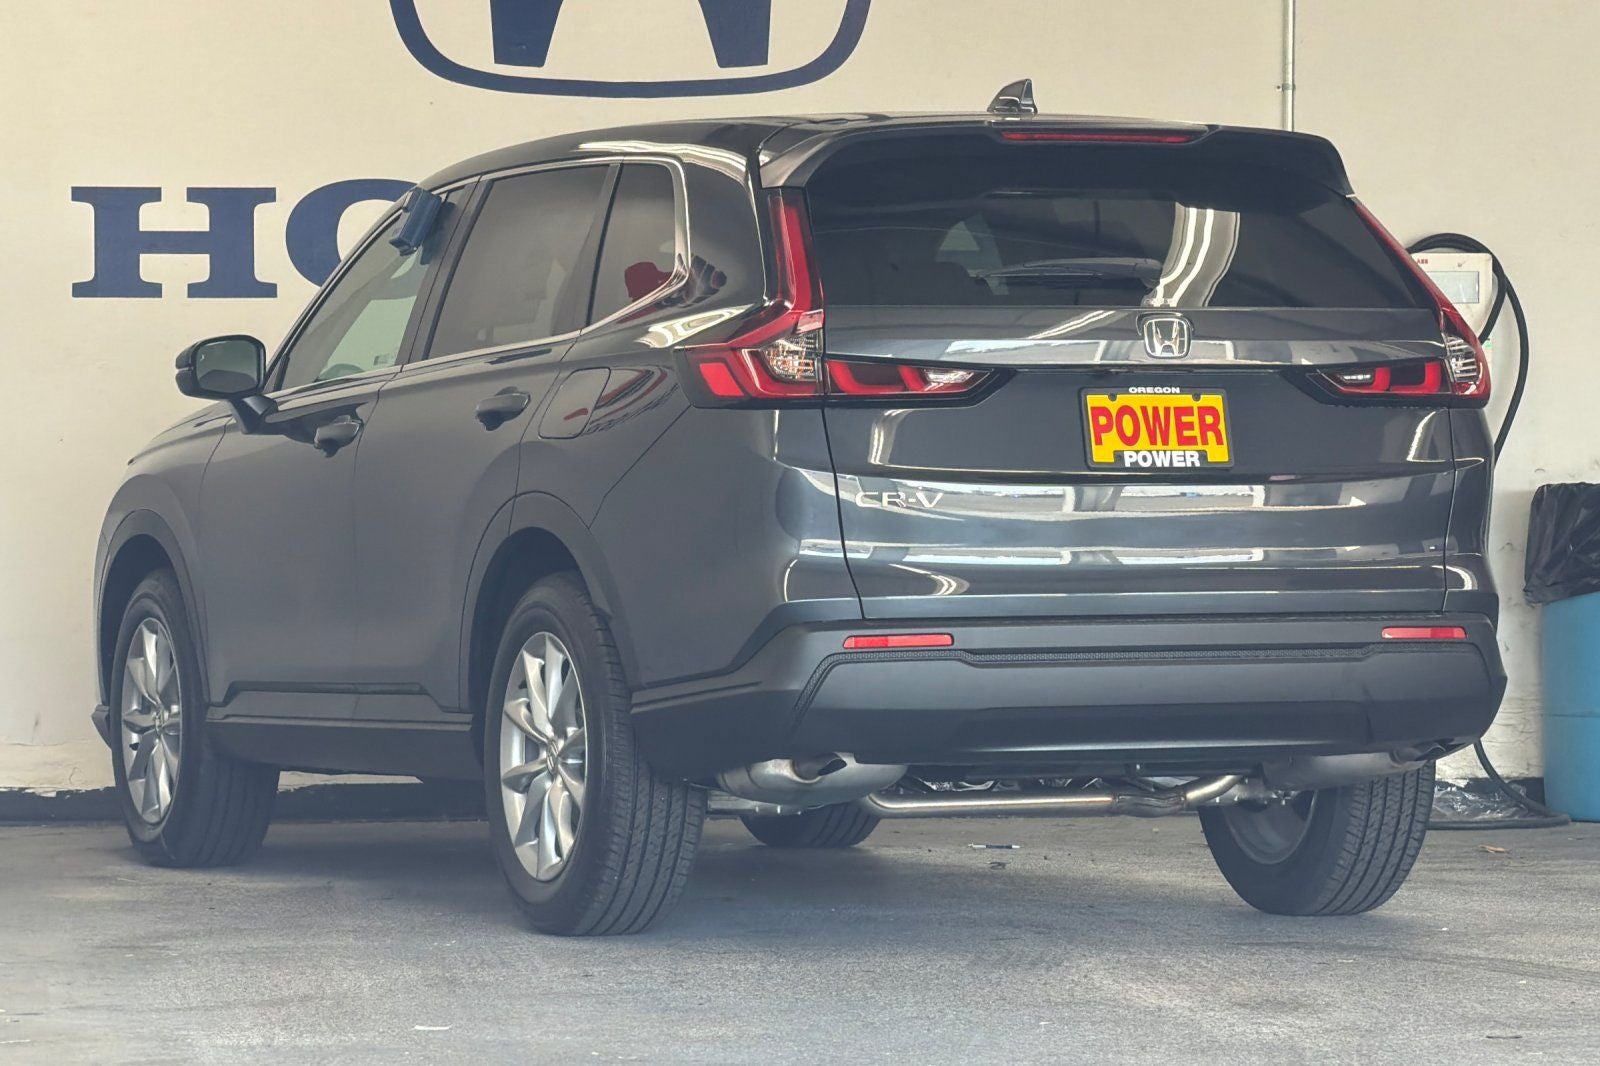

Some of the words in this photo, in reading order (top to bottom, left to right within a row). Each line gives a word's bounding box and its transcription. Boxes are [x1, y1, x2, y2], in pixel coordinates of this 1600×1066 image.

[1128, 386, 1180, 394] OREGON
[1090, 405, 1224, 446] POWER
[1124, 450, 1200, 467] POWER
[855, 491, 944, 508] CR-V
